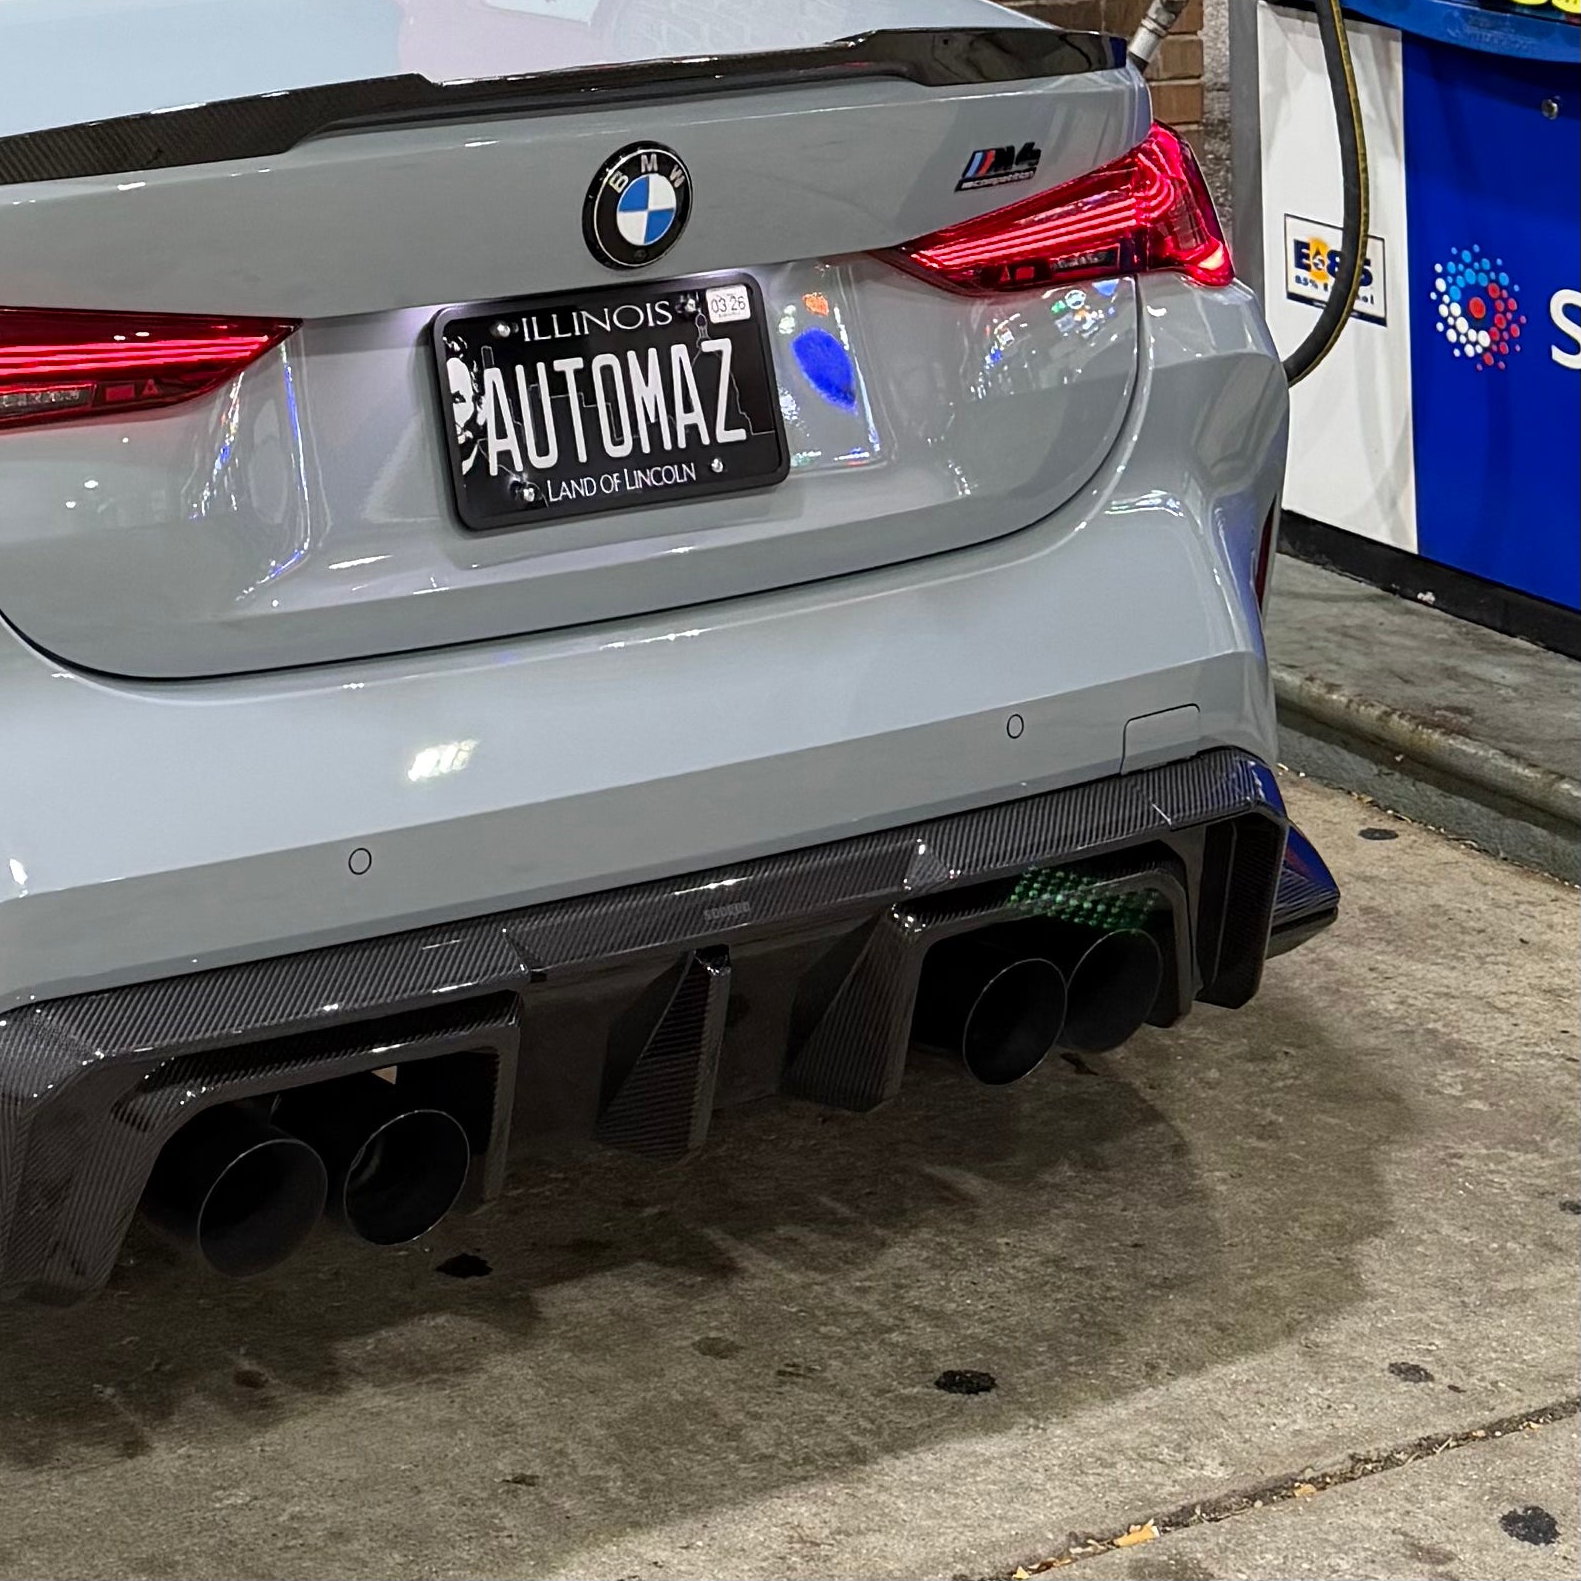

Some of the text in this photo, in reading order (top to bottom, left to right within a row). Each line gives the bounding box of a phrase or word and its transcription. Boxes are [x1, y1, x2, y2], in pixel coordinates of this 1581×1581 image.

[608, 153, 686, 194] BMW
[521, 300, 673, 342] ILLINOIS
[711, 295, 746, 313] 03 26
[483, 337, 747, 476] AUTOMAZ
[547, 463, 697, 503] LAND OF LINCOLN
